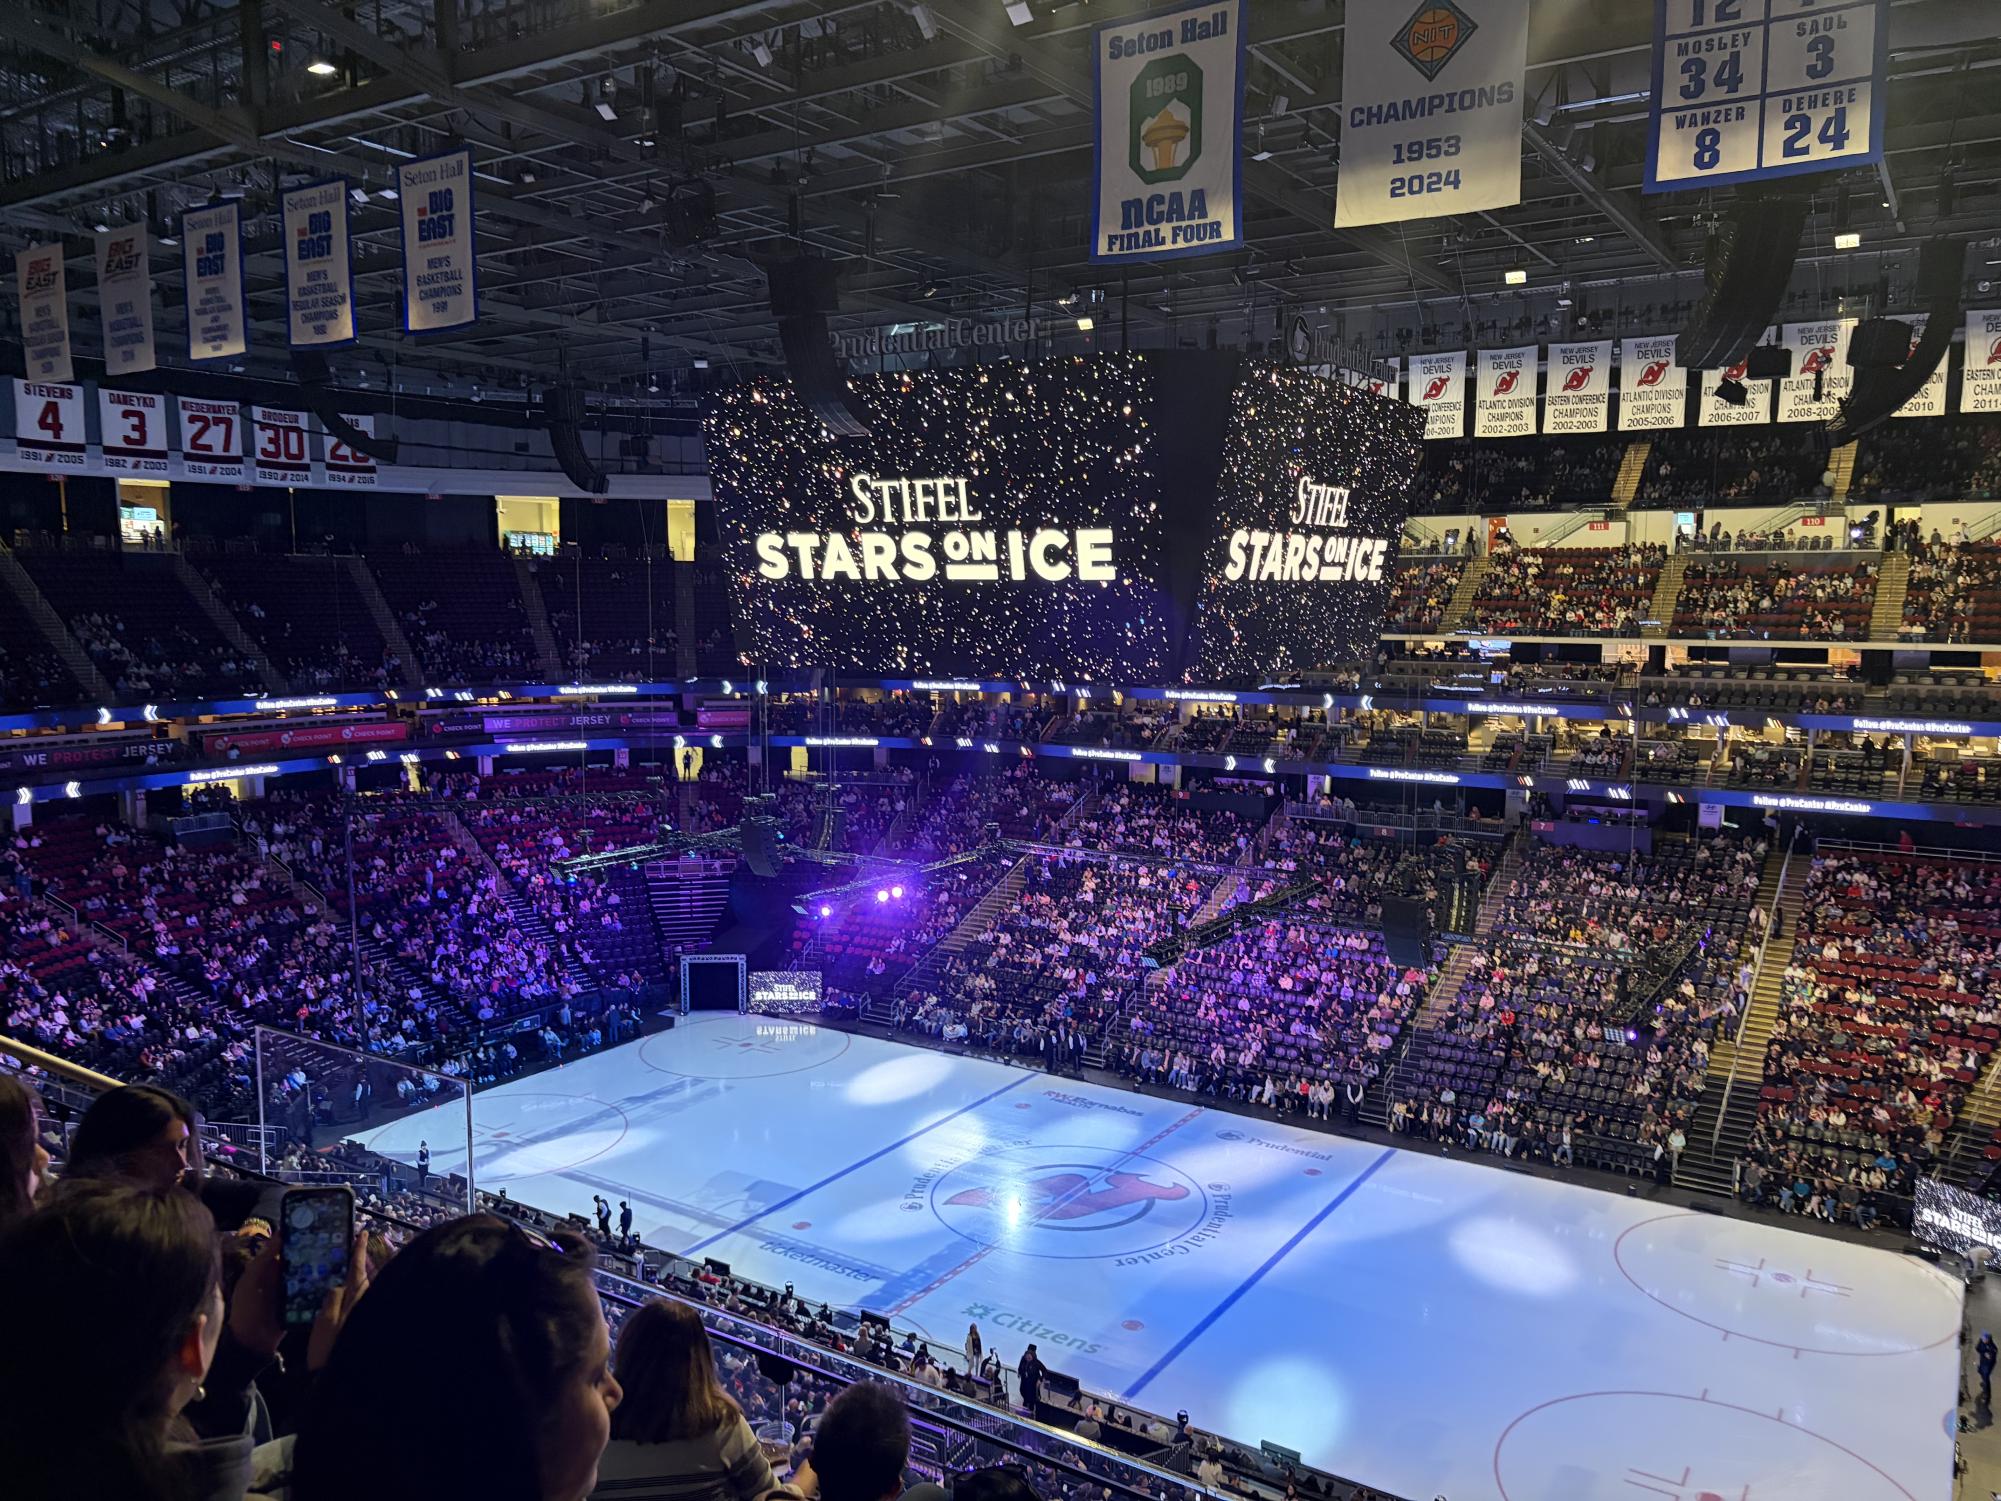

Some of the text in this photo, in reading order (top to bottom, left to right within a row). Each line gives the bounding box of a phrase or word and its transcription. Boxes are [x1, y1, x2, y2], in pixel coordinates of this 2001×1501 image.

[1796, 14, 1847, 37] SAUL
[1109, 10, 1227, 60] Seton Hall
[1412, 24, 1455, 45] NIT
[1677, 31, 1752, 57] MOSLEY
[1805, 35, 1835, 80] 3
[1680, 50, 1743, 99] 34
[1146, 71, 1189, 98] 1989
[1350, 81, 1514, 128] CHAMPIONS
[1782, 87, 1858, 113] DEHERE
[1675, 106, 1746, 129] WANZER
[1782, 107, 1850, 158] 24
[1392, 135, 1461, 164] 1953
[1693, 127, 1721, 171] 8
[404, 160, 464, 187] Seton Hall
[1390, 169, 1461, 198] 2024
[429, 188, 454, 215] BIG
[418, 213, 455, 242] EAST
[1171, 220, 1222, 245] FOUR
[957, 317, 1041, 345] Center
[1797, 325, 1842, 335] NEW JERSEY
[1635, 339, 1674, 349] NEW JERSEY
[1800, 333, 1838, 346] DEVILS
[1503, 351, 1525, 360] JERSEY
[1560, 345, 1598, 355] NEW JERSEY
[1637, 347, 1671, 360] DEVILS
[1434, 356, 1455, 364] JERSEY
[1492, 359, 1522, 371] DEVILS
[1562, 353, 1595, 365] DEVILS
[1422, 363, 1451, 376] DEVILS
[1967, 368, 1995, 380] EASTERN
[24, 384, 73, 399] STEVENS
[1547, 392, 1605, 406] EASTERN CONFERENCE
[1622, 387, 1683, 402] ATLANTIC DIVISION
[109, 392, 155, 408] DANEYKO
[1432, 401, 1462, 412] CONFERENCE
[1478, 396, 1535, 411] ATLANTIC DIVISION
[1487, 410, 1524, 422] CHAMPIONS
[1553, 406, 1599, 419] CHAMPIONS
[1632, 403, 1671, 415] CHAMPIONS
[37, 401, 63, 439] 4
[261, 410, 299, 425] BRODEUR
[1627, 415, 1675, 427] 2005-2006
[1708, 411, 1760, 423] 2006-2007
[121, 409, 147, 446] 3
[1426, 426, 1456, 437] 00-2001
[1482, 423, 1529, 434] 2002-2003
[1552, 420, 1598, 431] 2002-2003
[187, 414, 233, 453] 27
[258, 423, 305, 461] 30
[21, 450, 84, 464] 1991 2005
[143, 460, 168, 471] 2003
[187, 465, 242, 476] 1991 2004
[259, 471, 309, 483] 1990 2014
[357, 475, 375, 485] 2016
[850, 474, 982, 523] STIFEL
[1292, 476, 1350, 528] STIFEL
[1594, 522, 1604, 530] 111
[1807, 518, 1820, 526] 110
[756, 528, 1116, 581] STARS ON ICE
[1225, 529, 1388, 581] STARS ON ICE
[444, 725, 463, 733] CHECK
[493, 715, 611, 730] WE PROTECT JERSEY
[24, 754, 47, 766] WE
[53, 747, 119, 764] PROTECT
[123, 743, 173, 757] JERSEY
[1540, 821, 1546, 830] 7
[1246, 1136, 1334, 1162] Prudential
[1184, 1194, 1233, 1248] Prudential
[1923, 1208, 1971, 1238] STARS
[759, 1239, 880, 1283] ticketmaster
[1115, 1244, 1190, 1267] Center
[992, 1311, 1103, 1355] Citizens
